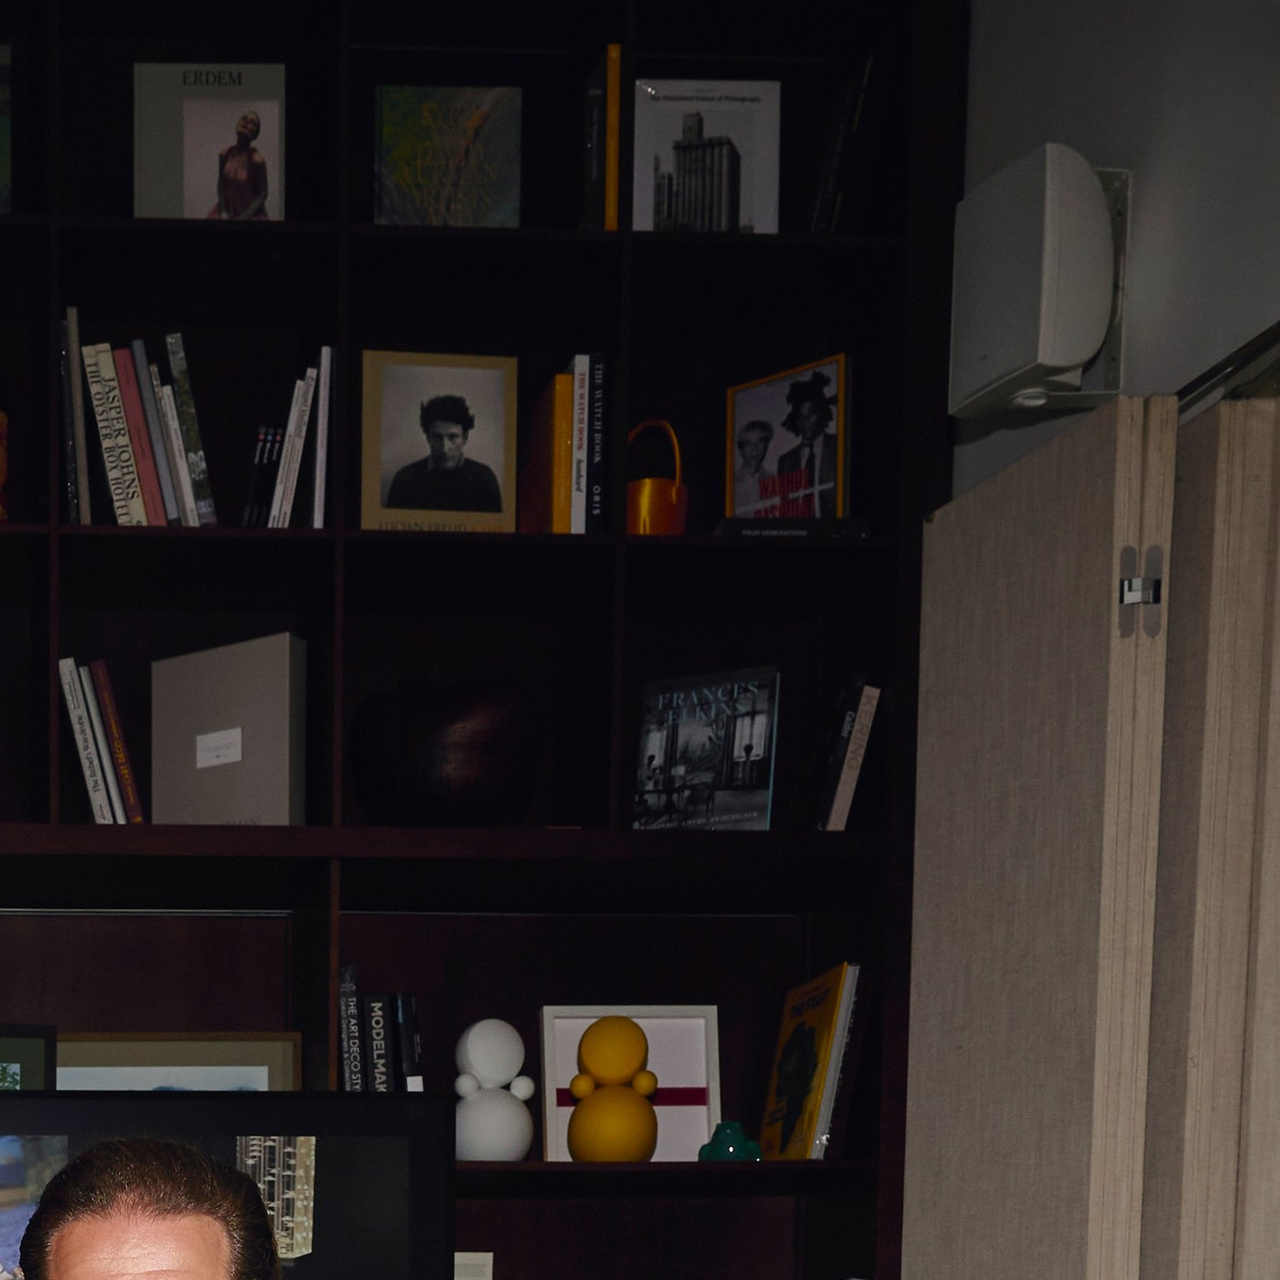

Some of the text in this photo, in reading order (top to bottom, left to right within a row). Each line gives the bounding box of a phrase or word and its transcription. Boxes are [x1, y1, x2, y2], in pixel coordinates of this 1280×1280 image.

[181, 69, 243, 87] ERDEM
[85, 361, 100, 386] THE
[93, 391, 113, 441] OYSTER
[103, 445, 120, 473] BOX
[101, 375, 141, 502] JASPER JOHNS
[592, 485, 601, 515] ORIS
[657, 681, 759, 710] FRANCES
[667, 701, 747, 725] ELKINS
[846, 694, 876, 771] KERING
[348, 997, 357, 1015] THE
[349, 1018, 358, 1037] ART
[350, 1039, 360, 1071] DECO
